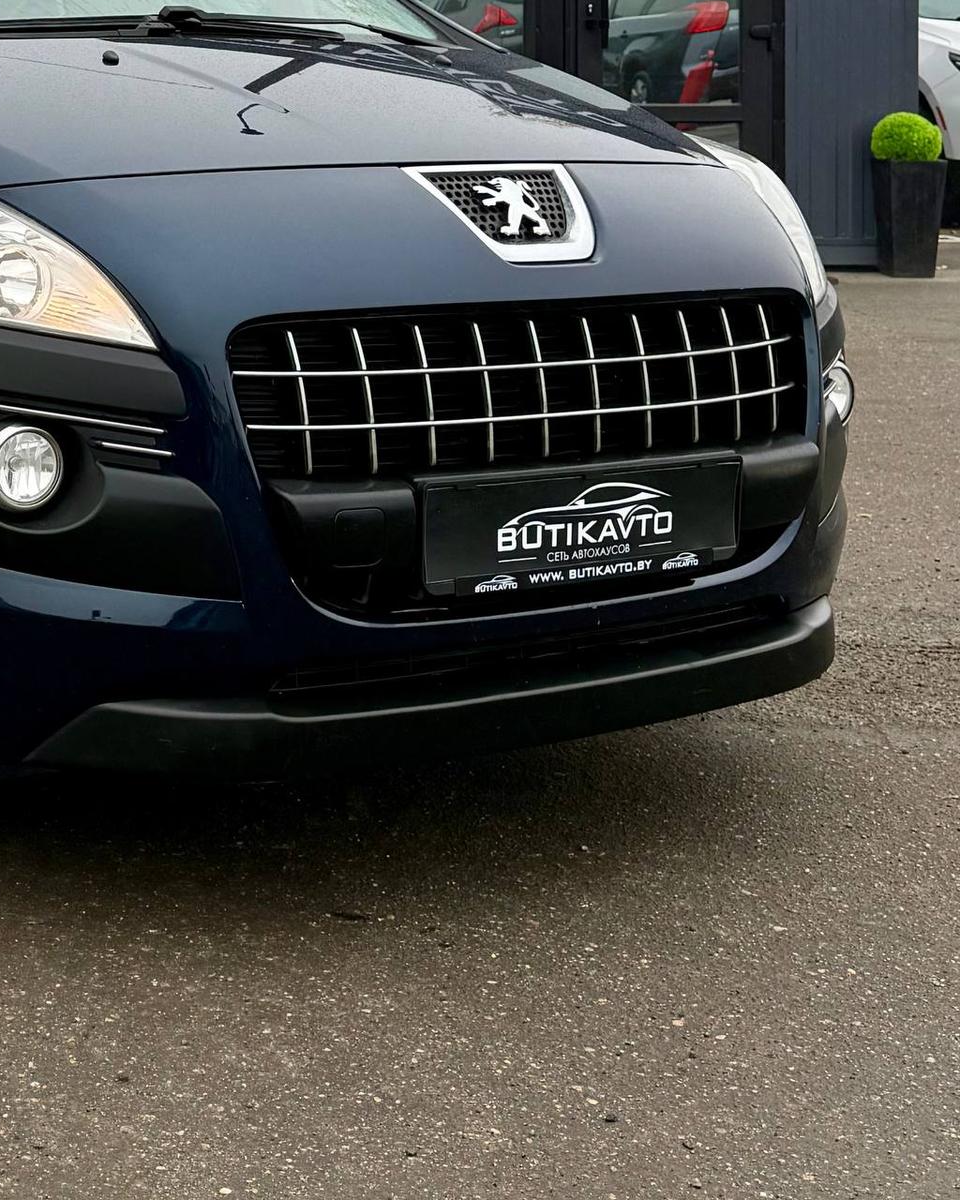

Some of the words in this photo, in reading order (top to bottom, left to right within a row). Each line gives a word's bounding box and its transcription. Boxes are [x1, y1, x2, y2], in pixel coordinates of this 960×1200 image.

[497, 511, 673, 552] BUTIKAVTO
[546, 551, 570, 563] СЕТЬ
[571, 544, 631, 561] АВТОХАУСОВ
[528, 570, 565, 584] WWW.
[568, 559, 653, 580] BUTIKAVTO.BY
[661, 558, 700, 571] BUTIKAVTO
[474, 581, 519, 593] BUTIKAVTO
